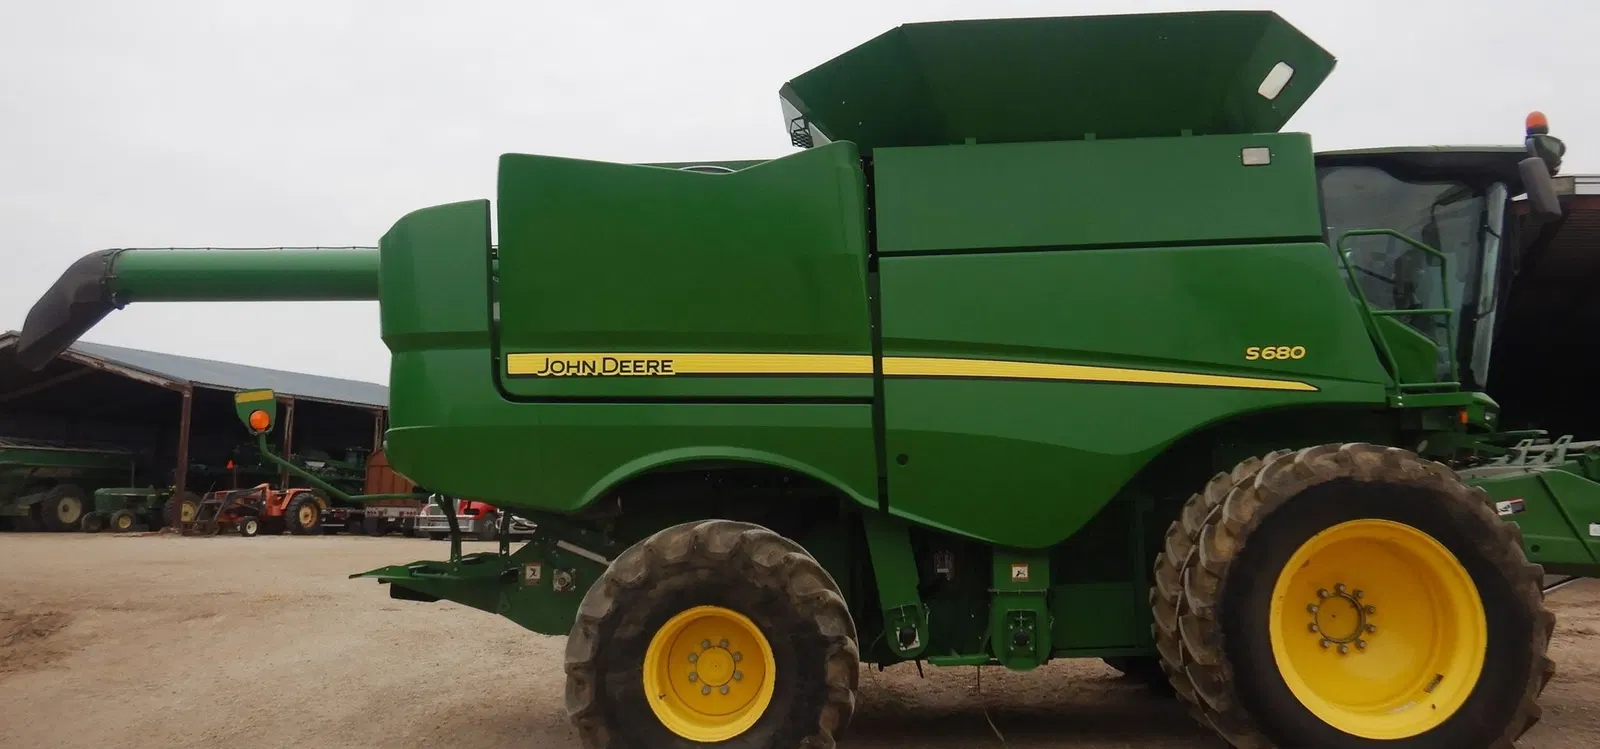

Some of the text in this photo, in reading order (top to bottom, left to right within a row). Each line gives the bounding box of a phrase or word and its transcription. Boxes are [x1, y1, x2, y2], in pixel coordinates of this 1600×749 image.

[1245, 345, 1306, 360] S680
[537, 357, 674, 374] JOHN DEERE
